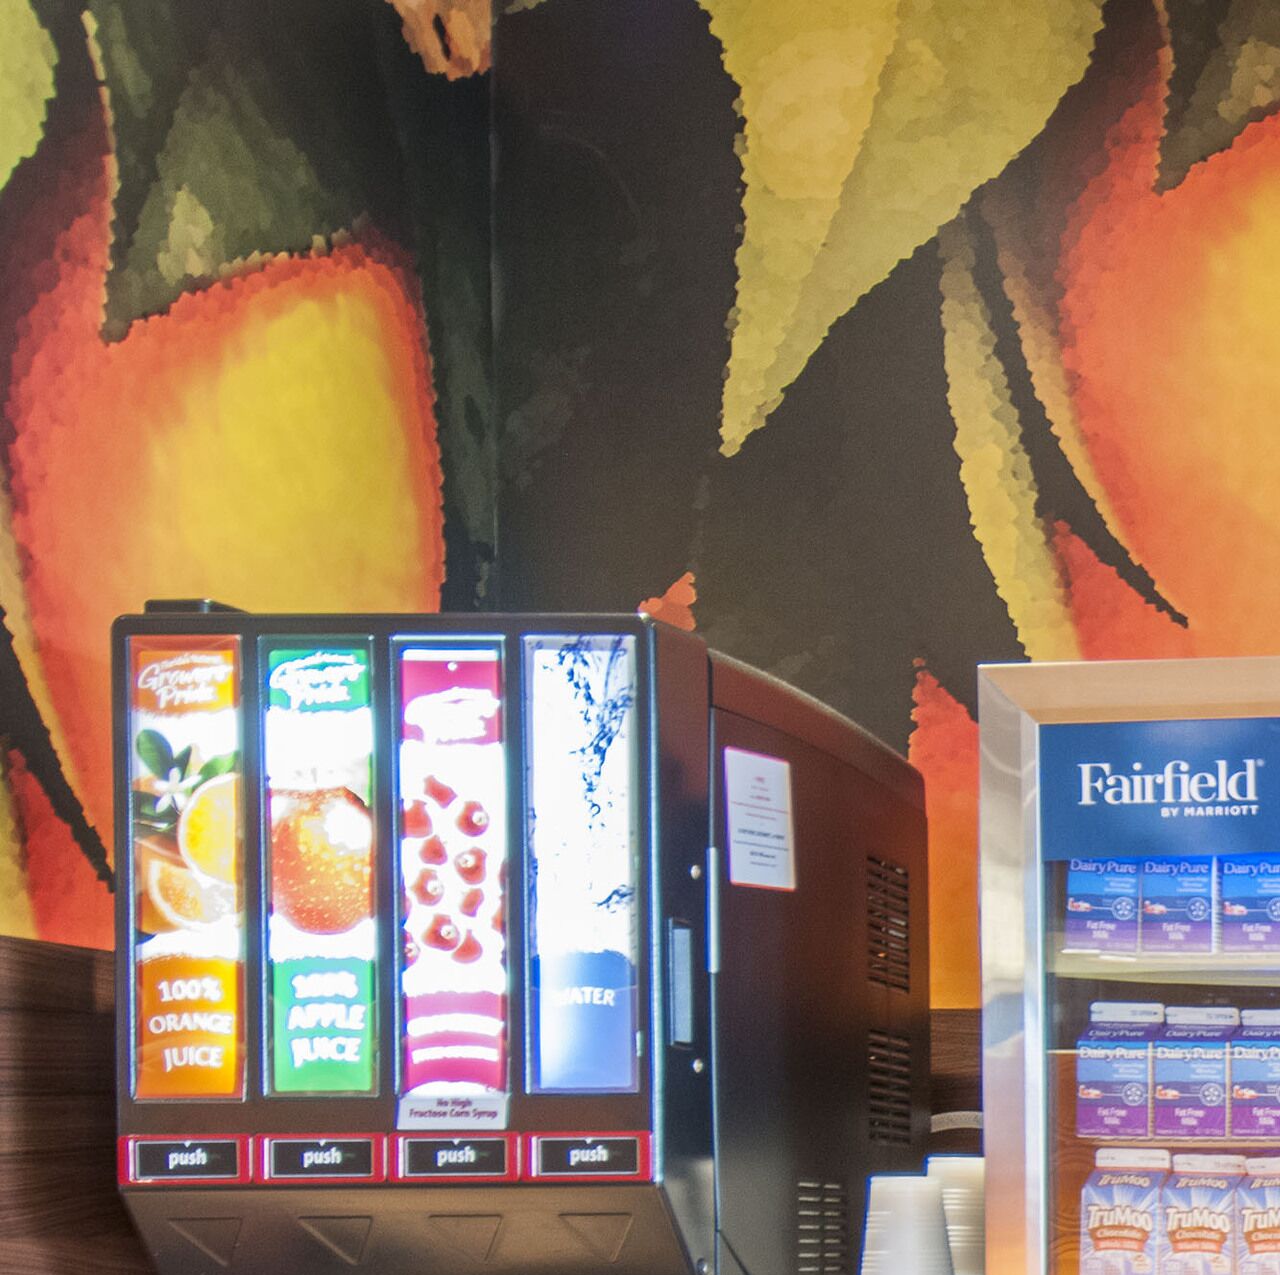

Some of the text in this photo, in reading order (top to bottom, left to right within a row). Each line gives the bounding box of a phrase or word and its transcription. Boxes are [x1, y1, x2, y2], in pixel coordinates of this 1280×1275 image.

[1077, 760, 1258, 805] Fairfield
[1161, 805, 1258, 817] BY MARRIOTT
[159, 978, 221, 1001] 100%
[149, 1012, 234, 1034] ORANGE
[288, 1003, 366, 1030] APPLE
[164, 1047, 224, 1072] JUICE
[292, 1037, 361, 1068] JUICE
[409, 1109, 498, 1118] Fructose Corn Syrup
[437, 1099, 472, 1108] No High
[168, 1149, 207, 1169] push
[303, 1147, 341, 1167] push
[437, 1147, 475, 1166] push
[570, 1146, 608, 1165] push
[1099, 1174, 1150, 1187] TruMoo
[1176, 1177, 1228, 1188] TruMoo
[1088, 1206, 1152, 1231] TruMoo
[1166, 1207, 1230, 1232] TruMoo
